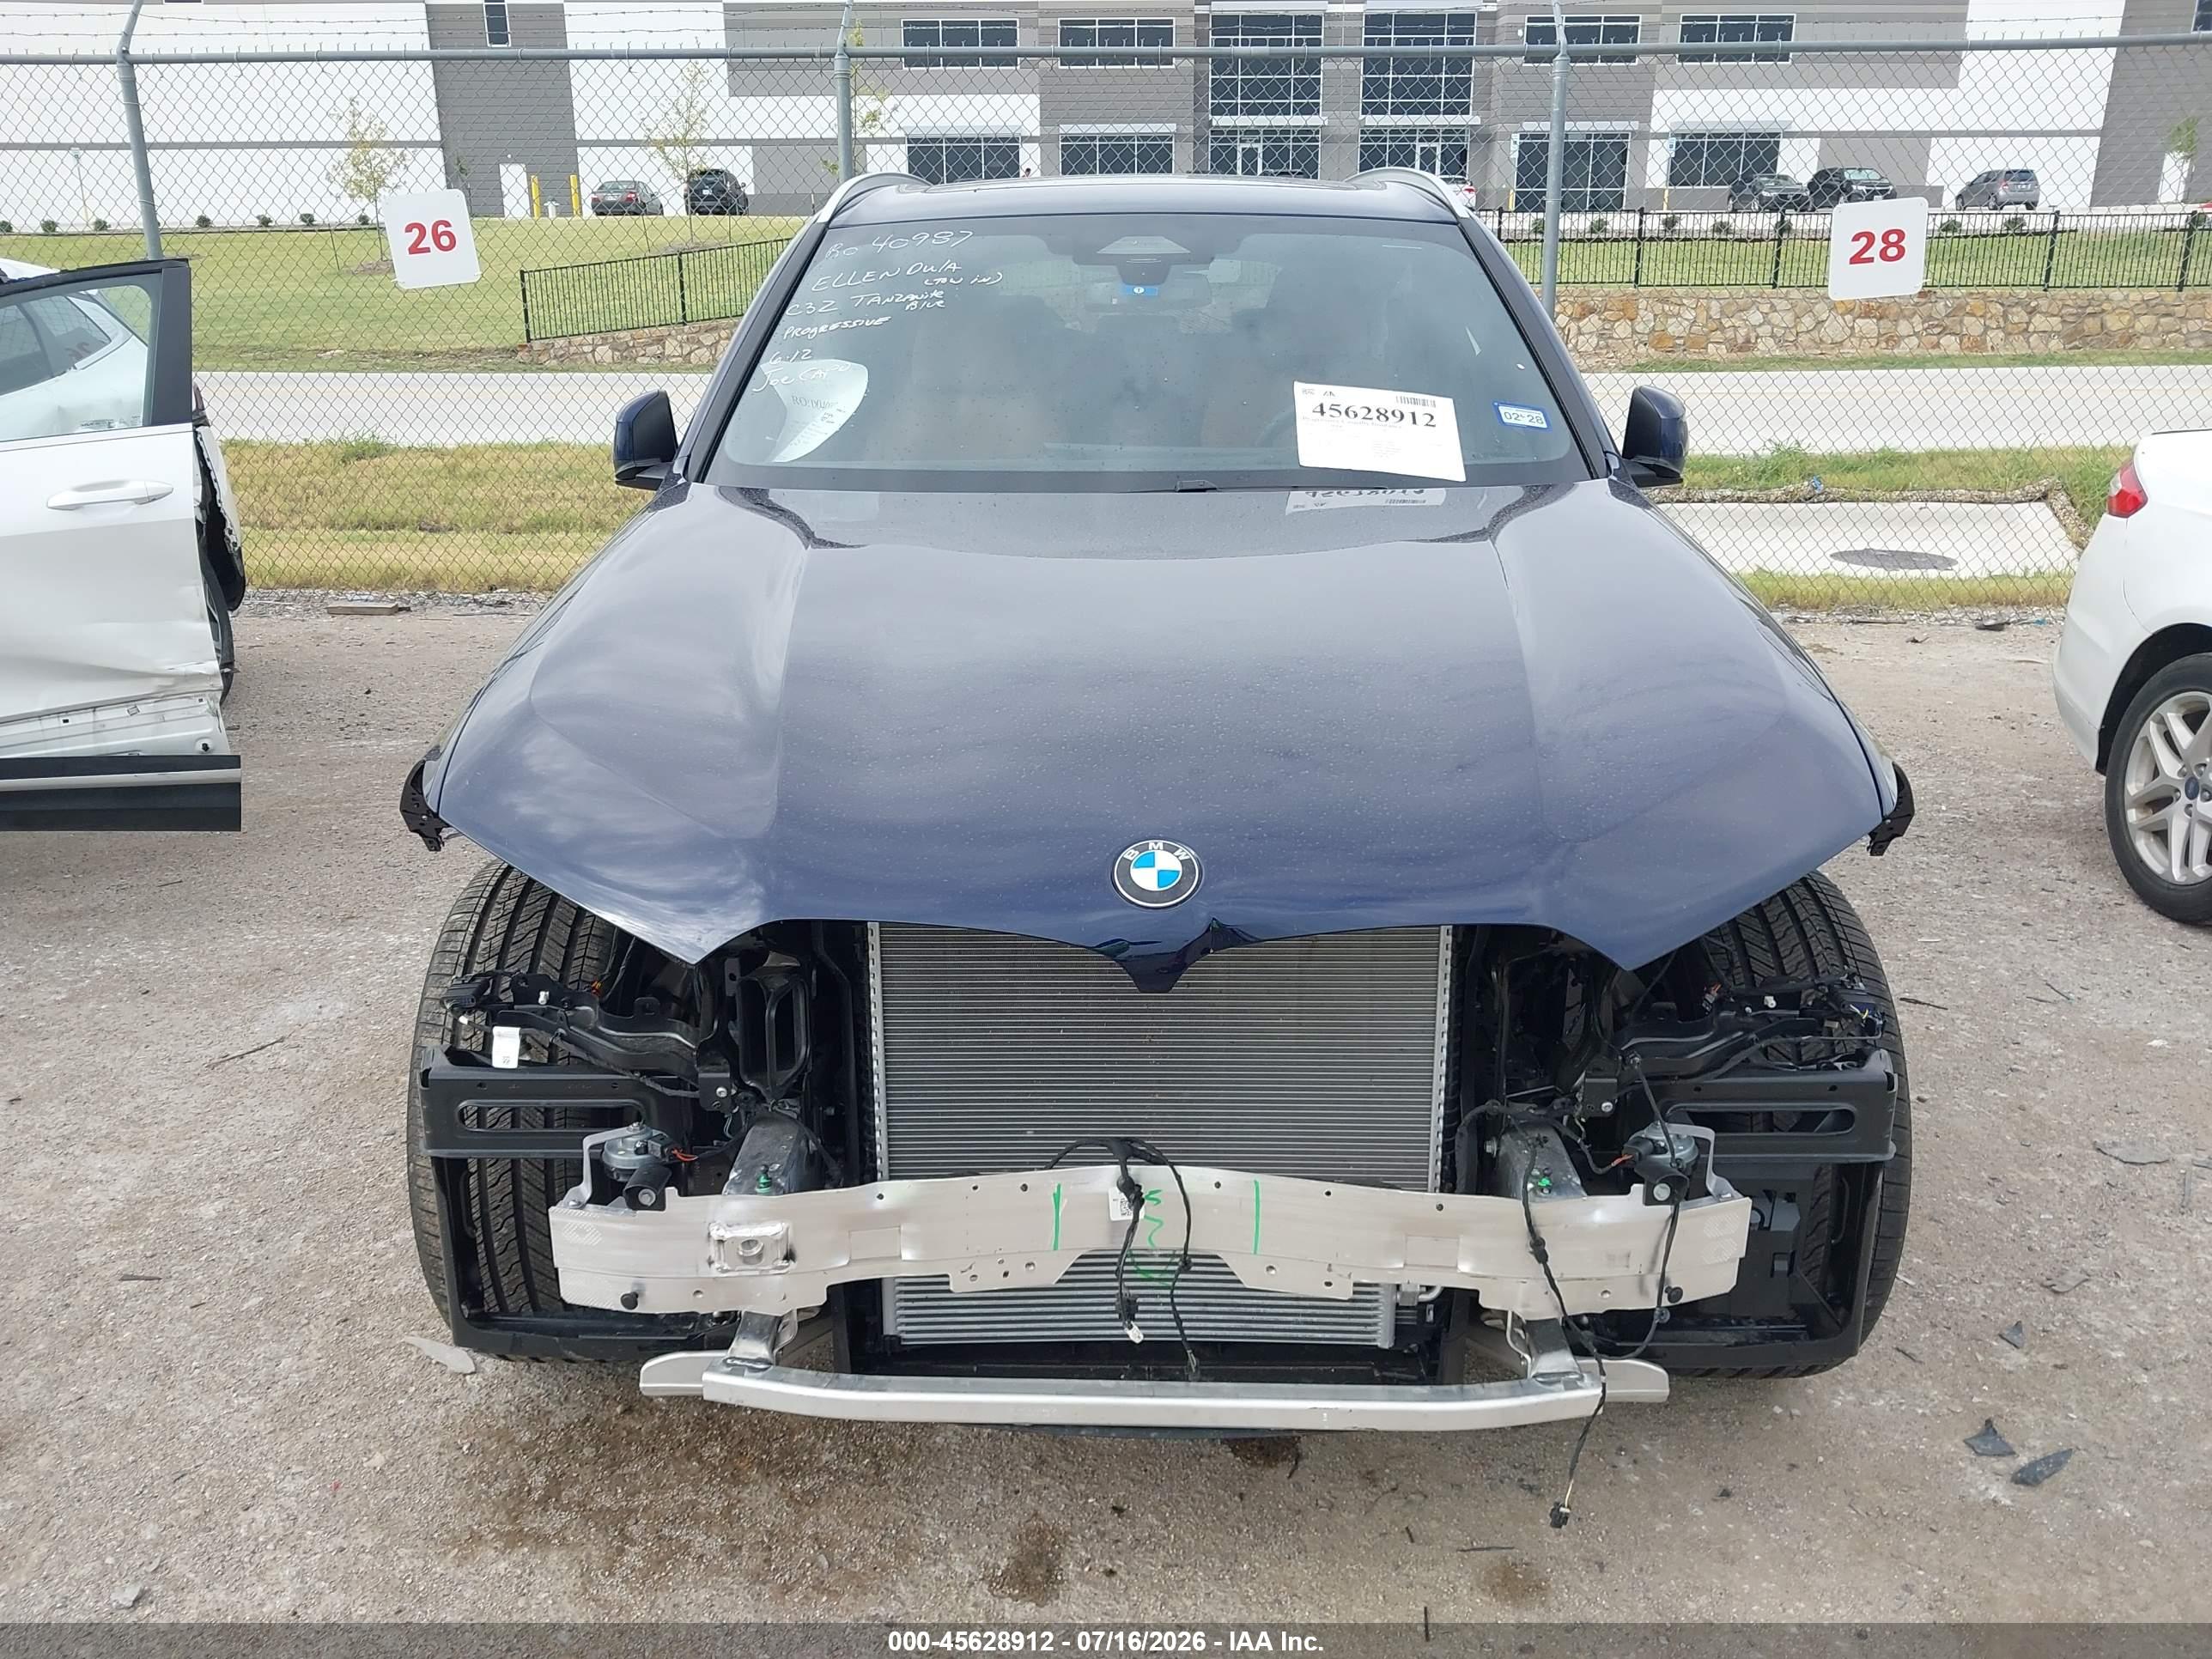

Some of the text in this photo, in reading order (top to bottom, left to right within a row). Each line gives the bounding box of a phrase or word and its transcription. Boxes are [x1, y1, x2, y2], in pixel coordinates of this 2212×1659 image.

[404, 220, 457, 255] 26
[872, 230, 974, 254] 40987
[1849, 228, 1905, 264] 28
[811, 267, 901, 291] ELLEN
[1312, 402, 1437, 428] 45628912
[1123, 842, 1190, 861] BMW
